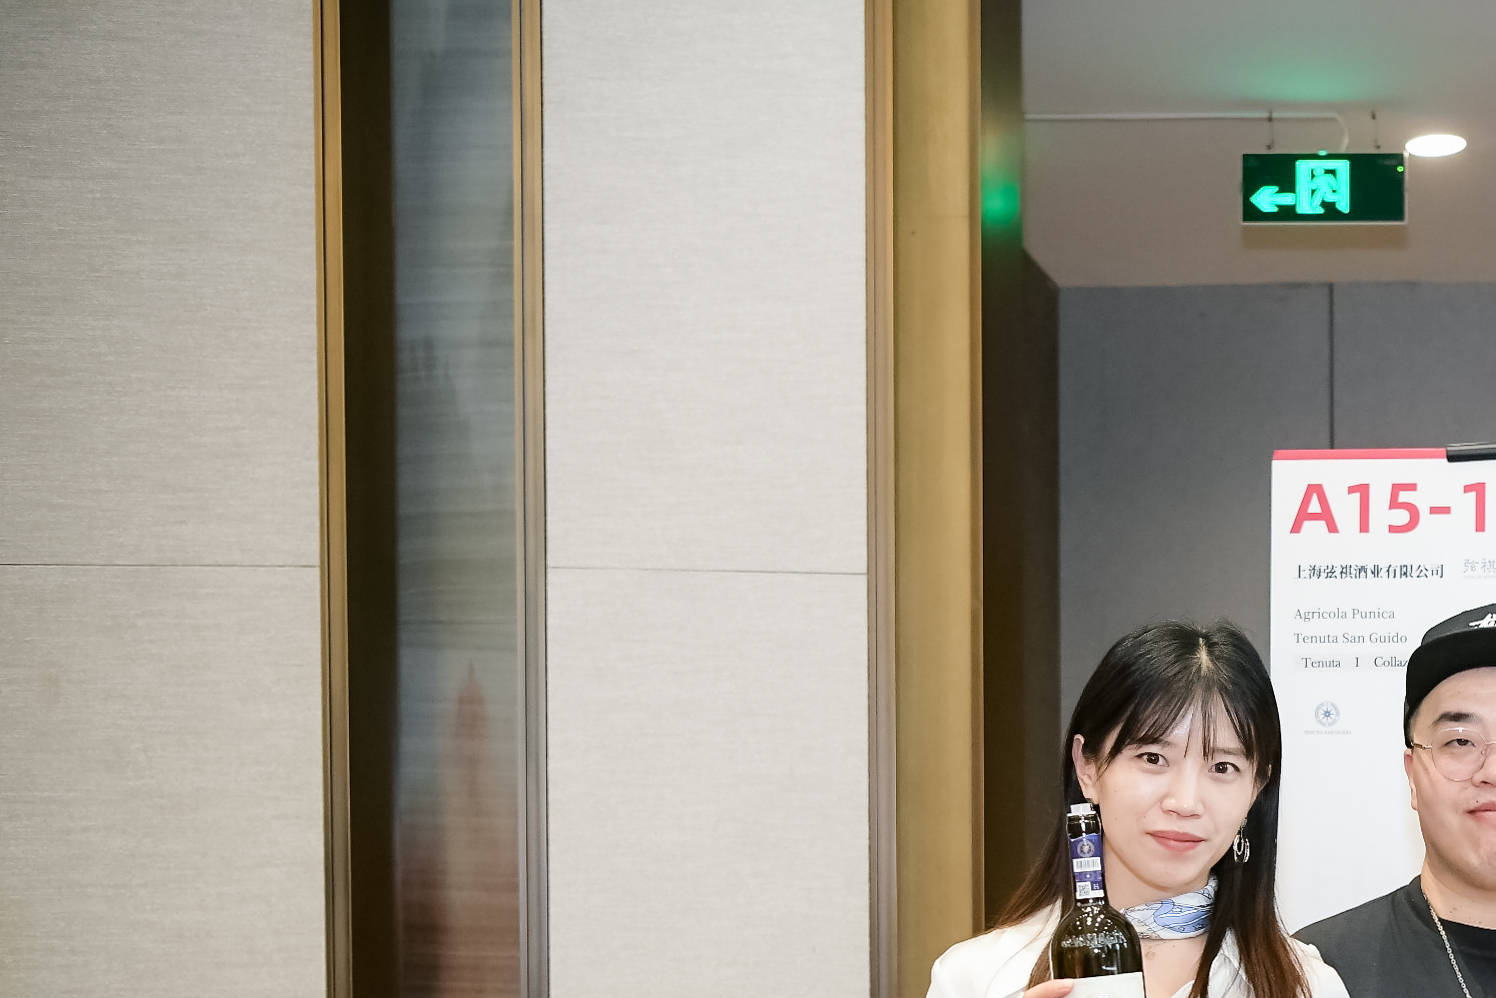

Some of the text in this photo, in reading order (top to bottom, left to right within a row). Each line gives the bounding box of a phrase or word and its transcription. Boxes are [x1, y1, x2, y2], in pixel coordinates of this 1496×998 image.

[1294, 563, 1445, 580] 上海弦祺酒业有限公司
[1294, 608, 1396, 622] Agricola Punica
[1294, 632, 1408, 644] Tenuta San Guido
[1301, 657, 1341, 669] Tenuta
